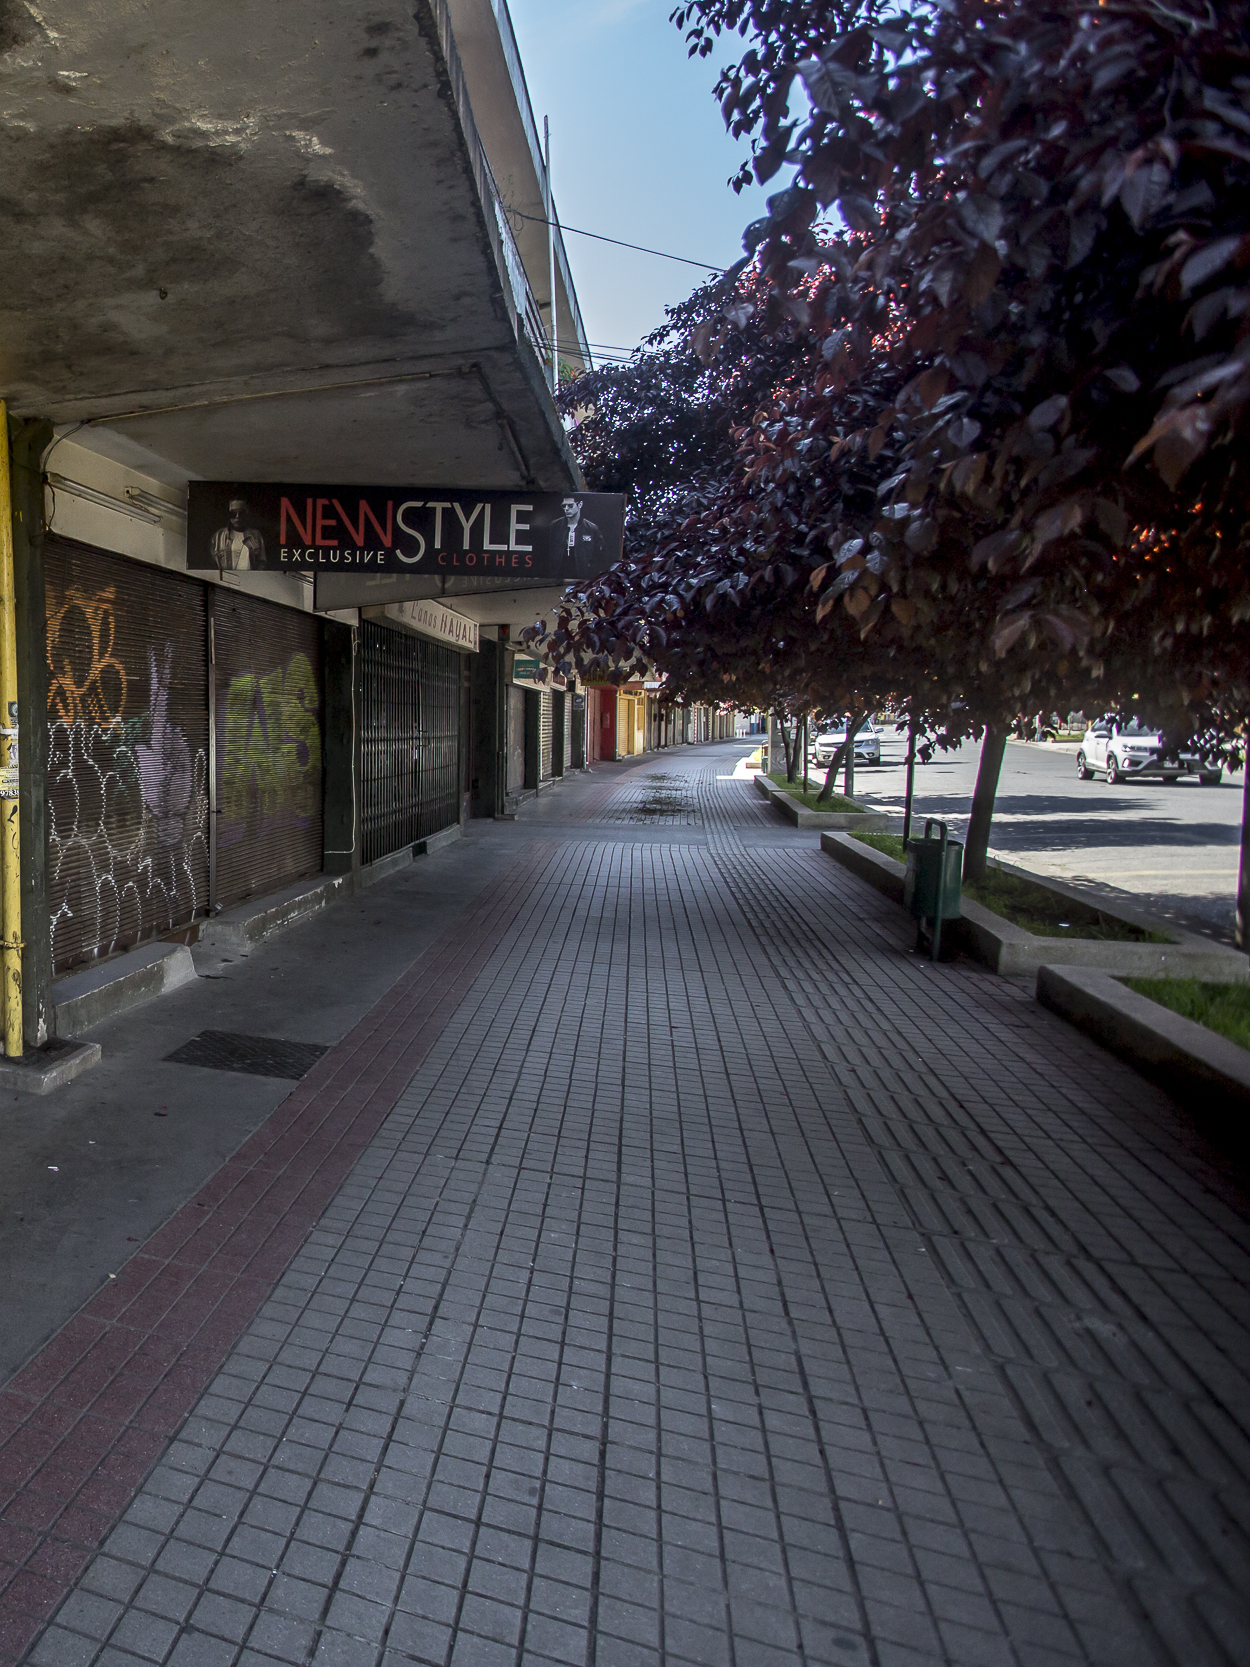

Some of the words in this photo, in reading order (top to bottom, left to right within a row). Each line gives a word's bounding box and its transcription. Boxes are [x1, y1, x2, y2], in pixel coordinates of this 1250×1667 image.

[280, 549, 385, 564] EXCLUSIVE
[438, 552, 533, 568] CLOTHES
[439, 612, 473, 645] HAYAL
